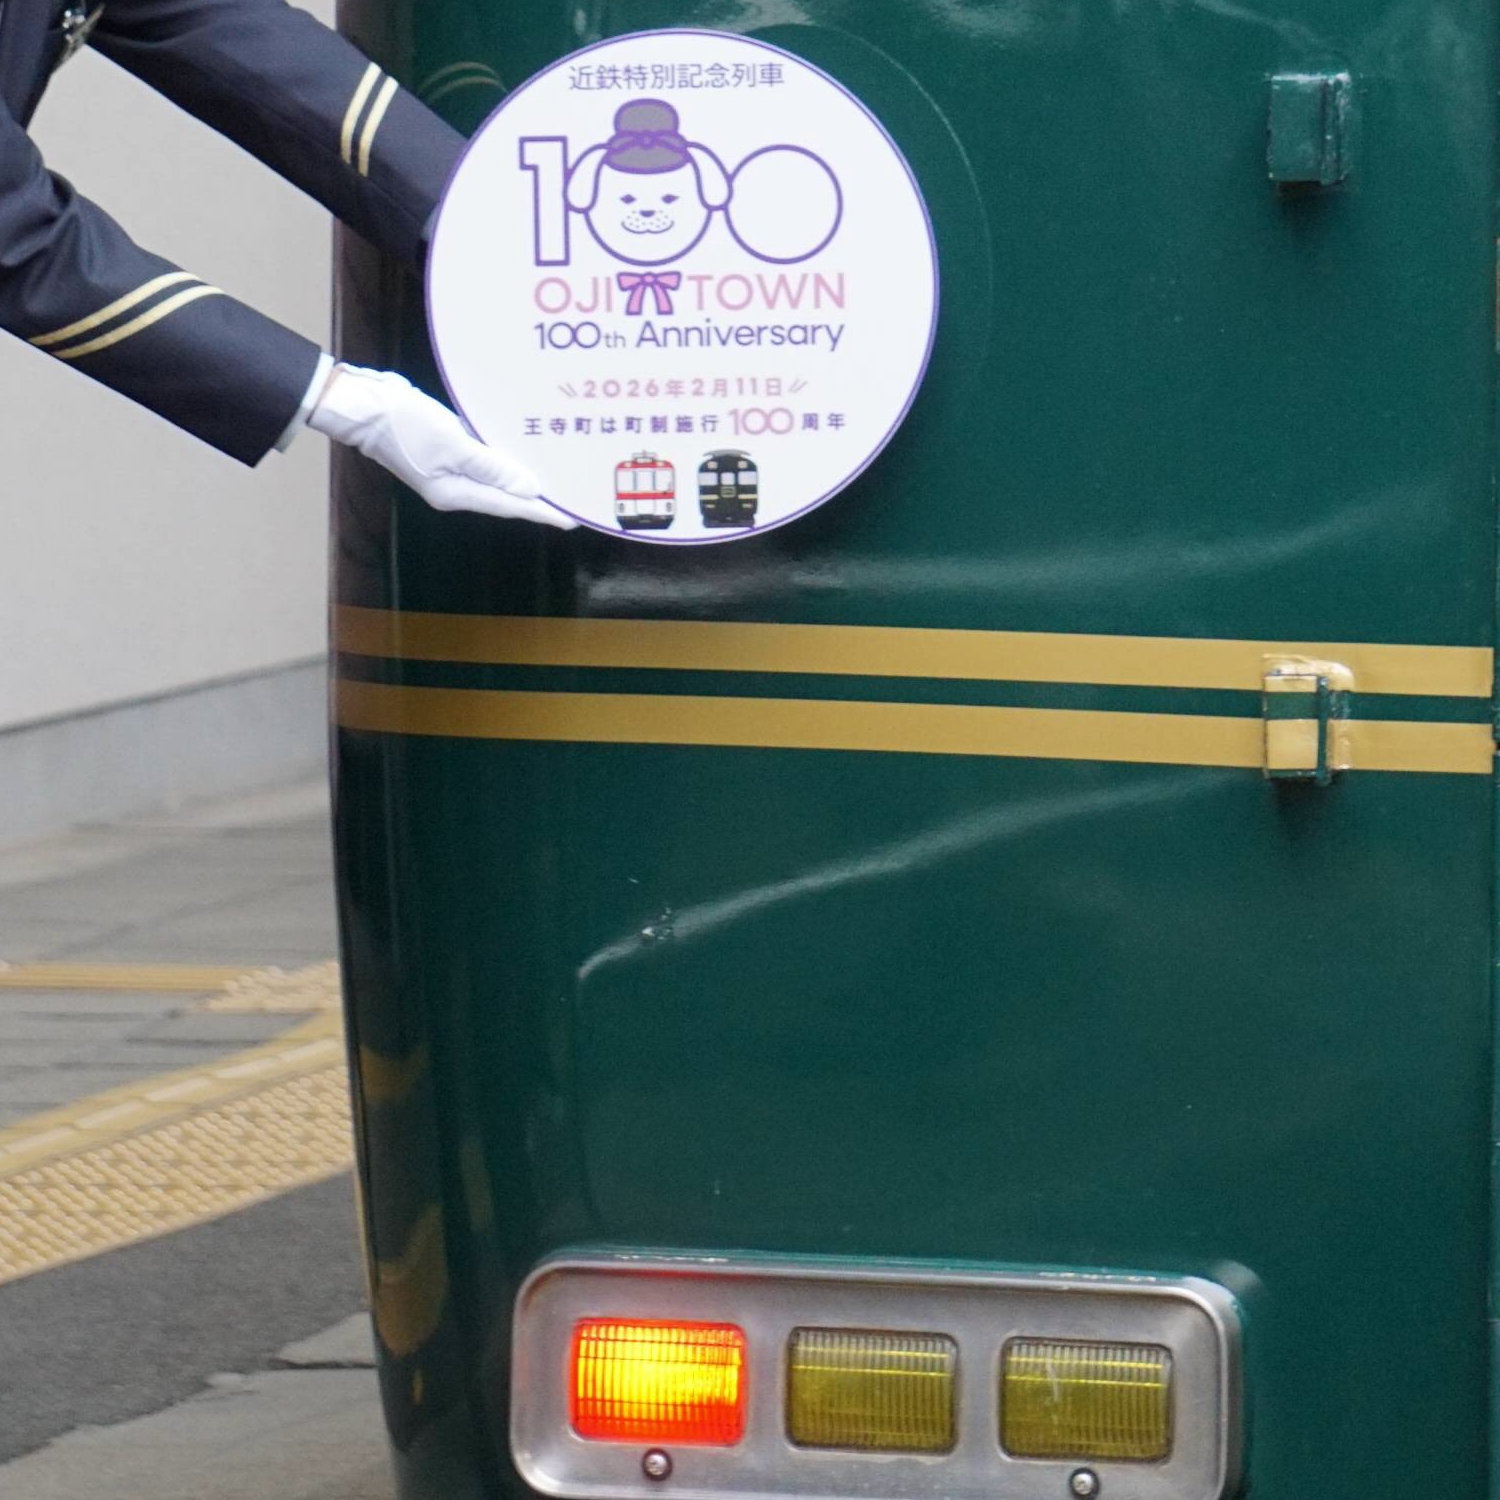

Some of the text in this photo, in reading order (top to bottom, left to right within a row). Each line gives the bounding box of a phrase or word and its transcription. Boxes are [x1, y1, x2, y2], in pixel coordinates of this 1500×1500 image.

[568, 62, 785, 91] 近鉄特別記念列車
[533, 272, 846, 315] OJI TOWN
[533, 317, 846, 352] 100th Anniversary
